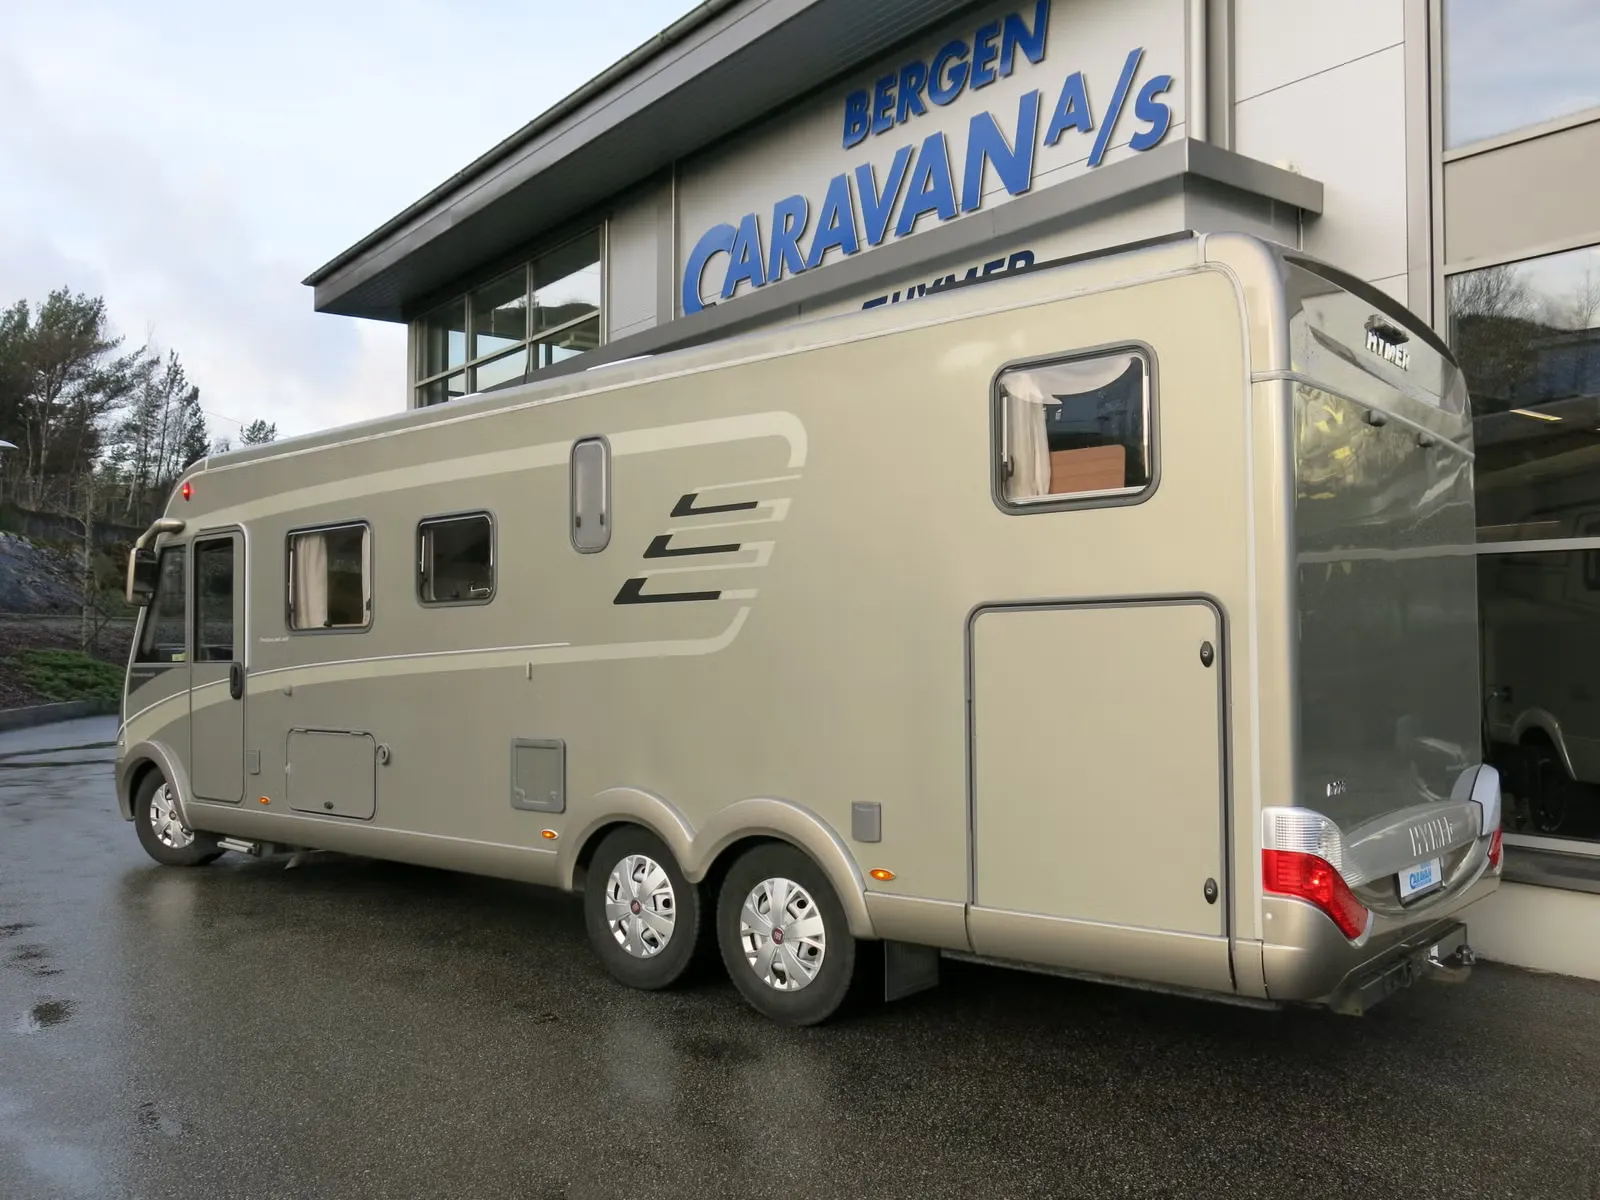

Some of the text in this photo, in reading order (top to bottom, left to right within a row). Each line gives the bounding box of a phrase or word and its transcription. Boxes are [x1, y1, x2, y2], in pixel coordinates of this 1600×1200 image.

[842, 0, 1050, 149] BERGEN
[682, 46, 1173, 316] CARAVAN A/S
[1366, 329, 1411, 371] HYMER
